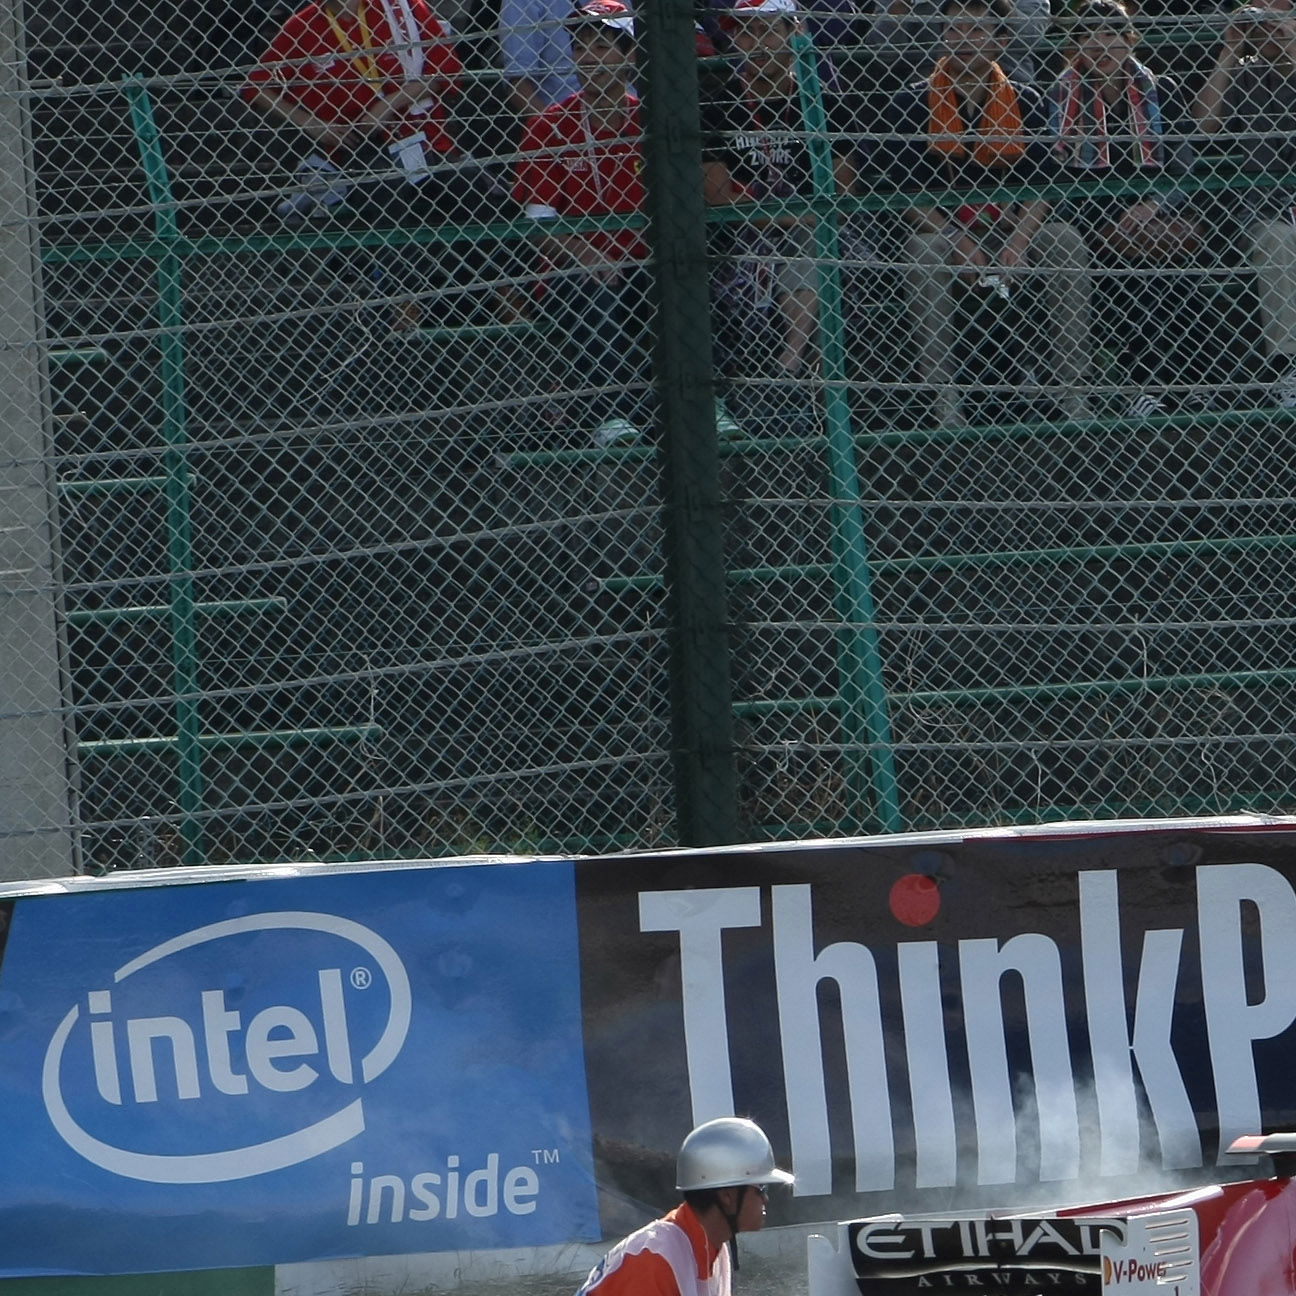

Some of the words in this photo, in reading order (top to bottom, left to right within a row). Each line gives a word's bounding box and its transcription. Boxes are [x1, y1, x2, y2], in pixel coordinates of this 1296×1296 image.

[88, 968, 353, 1105] intel
[346, 1152, 540, 1227] inside
[856, 1219, 1127, 1259] ETIHAD
[917, 1272, 1087, 1288] AIRWAYS
